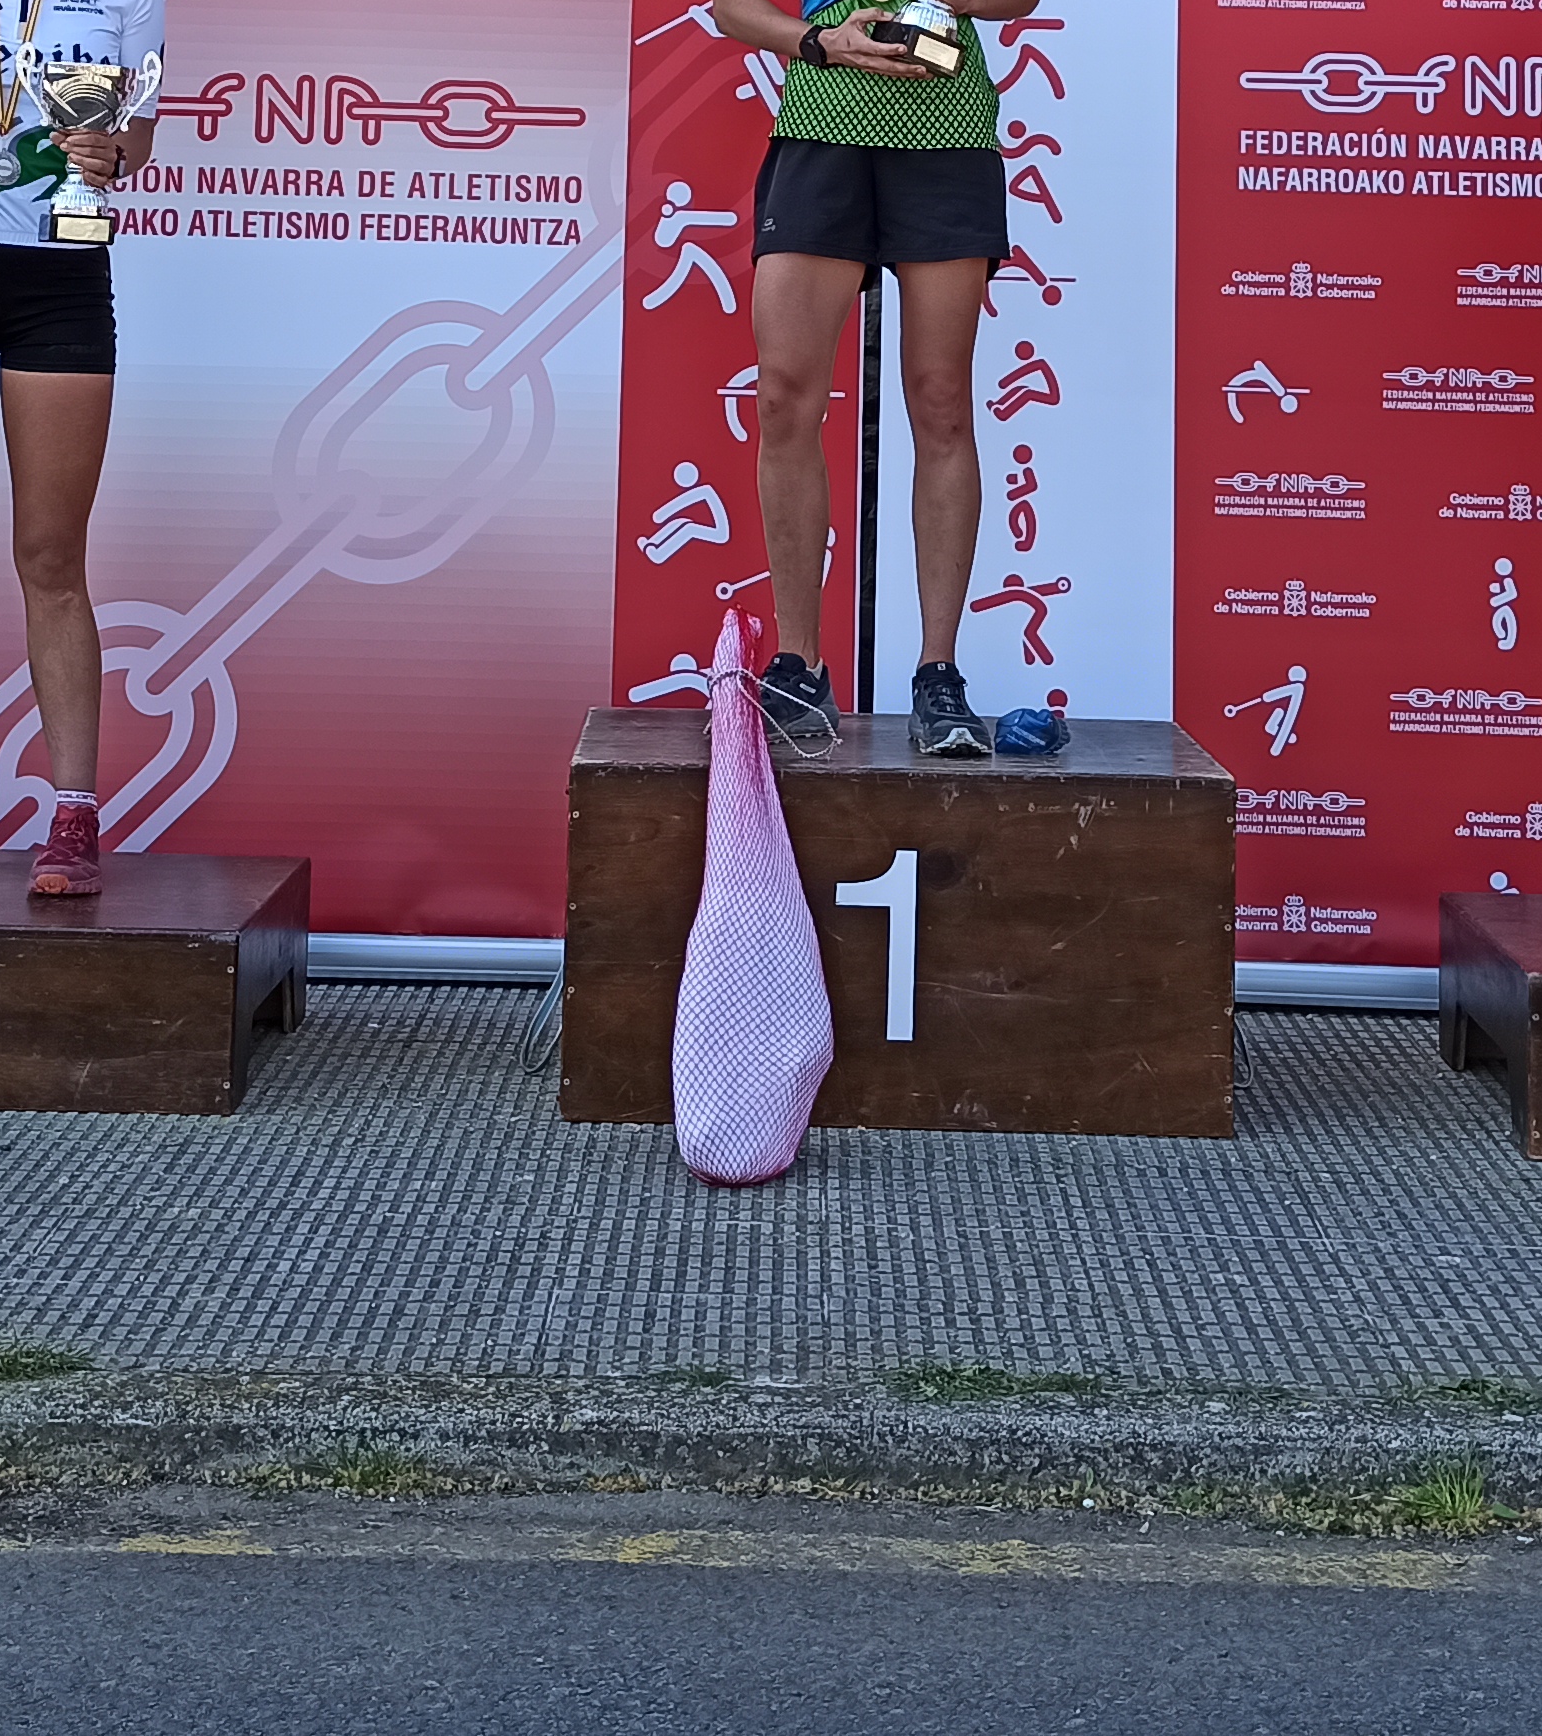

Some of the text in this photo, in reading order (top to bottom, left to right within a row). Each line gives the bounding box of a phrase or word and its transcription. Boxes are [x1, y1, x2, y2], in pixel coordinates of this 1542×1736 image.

[1241, 127, 1406, 157] FEDERACIÓN
[112, 159, 582, 203] CIÓN NAVARRA DE ATLETISMO
[1239, 167, 1404, 194] NAFARROAKO
[187, 210, 349, 240] ATLETISMO
[360, 214, 580, 245] FEDERAKUNTZA
[1232, 271, 1285, 282] Gobierno
[1317, 273, 1381, 285] Nafarroako
[1221, 284, 1285, 296] de Navarra
[1317, 287, 1375, 298] Gobernua
[1450, 493, 1504, 505] Gobierno
[1439, 507, 1504, 519] de Navarra
[1225, 589, 1279, 600] Gobierno
[1311, 591, 1376, 603] Nafarroako
[1214, 602, 1278, 614] de Navarra
[1311, 605, 1369, 617] Gobernua
[1236, 813, 1263, 822] ACIÓN
[1466, 812, 1521, 824] Gobierno
[1455, 826, 1521, 838] de Navarra
[1235, 904, 1277, 916] obierno
[1311, 907, 1377, 920] Nafarroako
[1311, 921, 1370, 933] Gobernua
[835, 849, 918, 1041] 1
